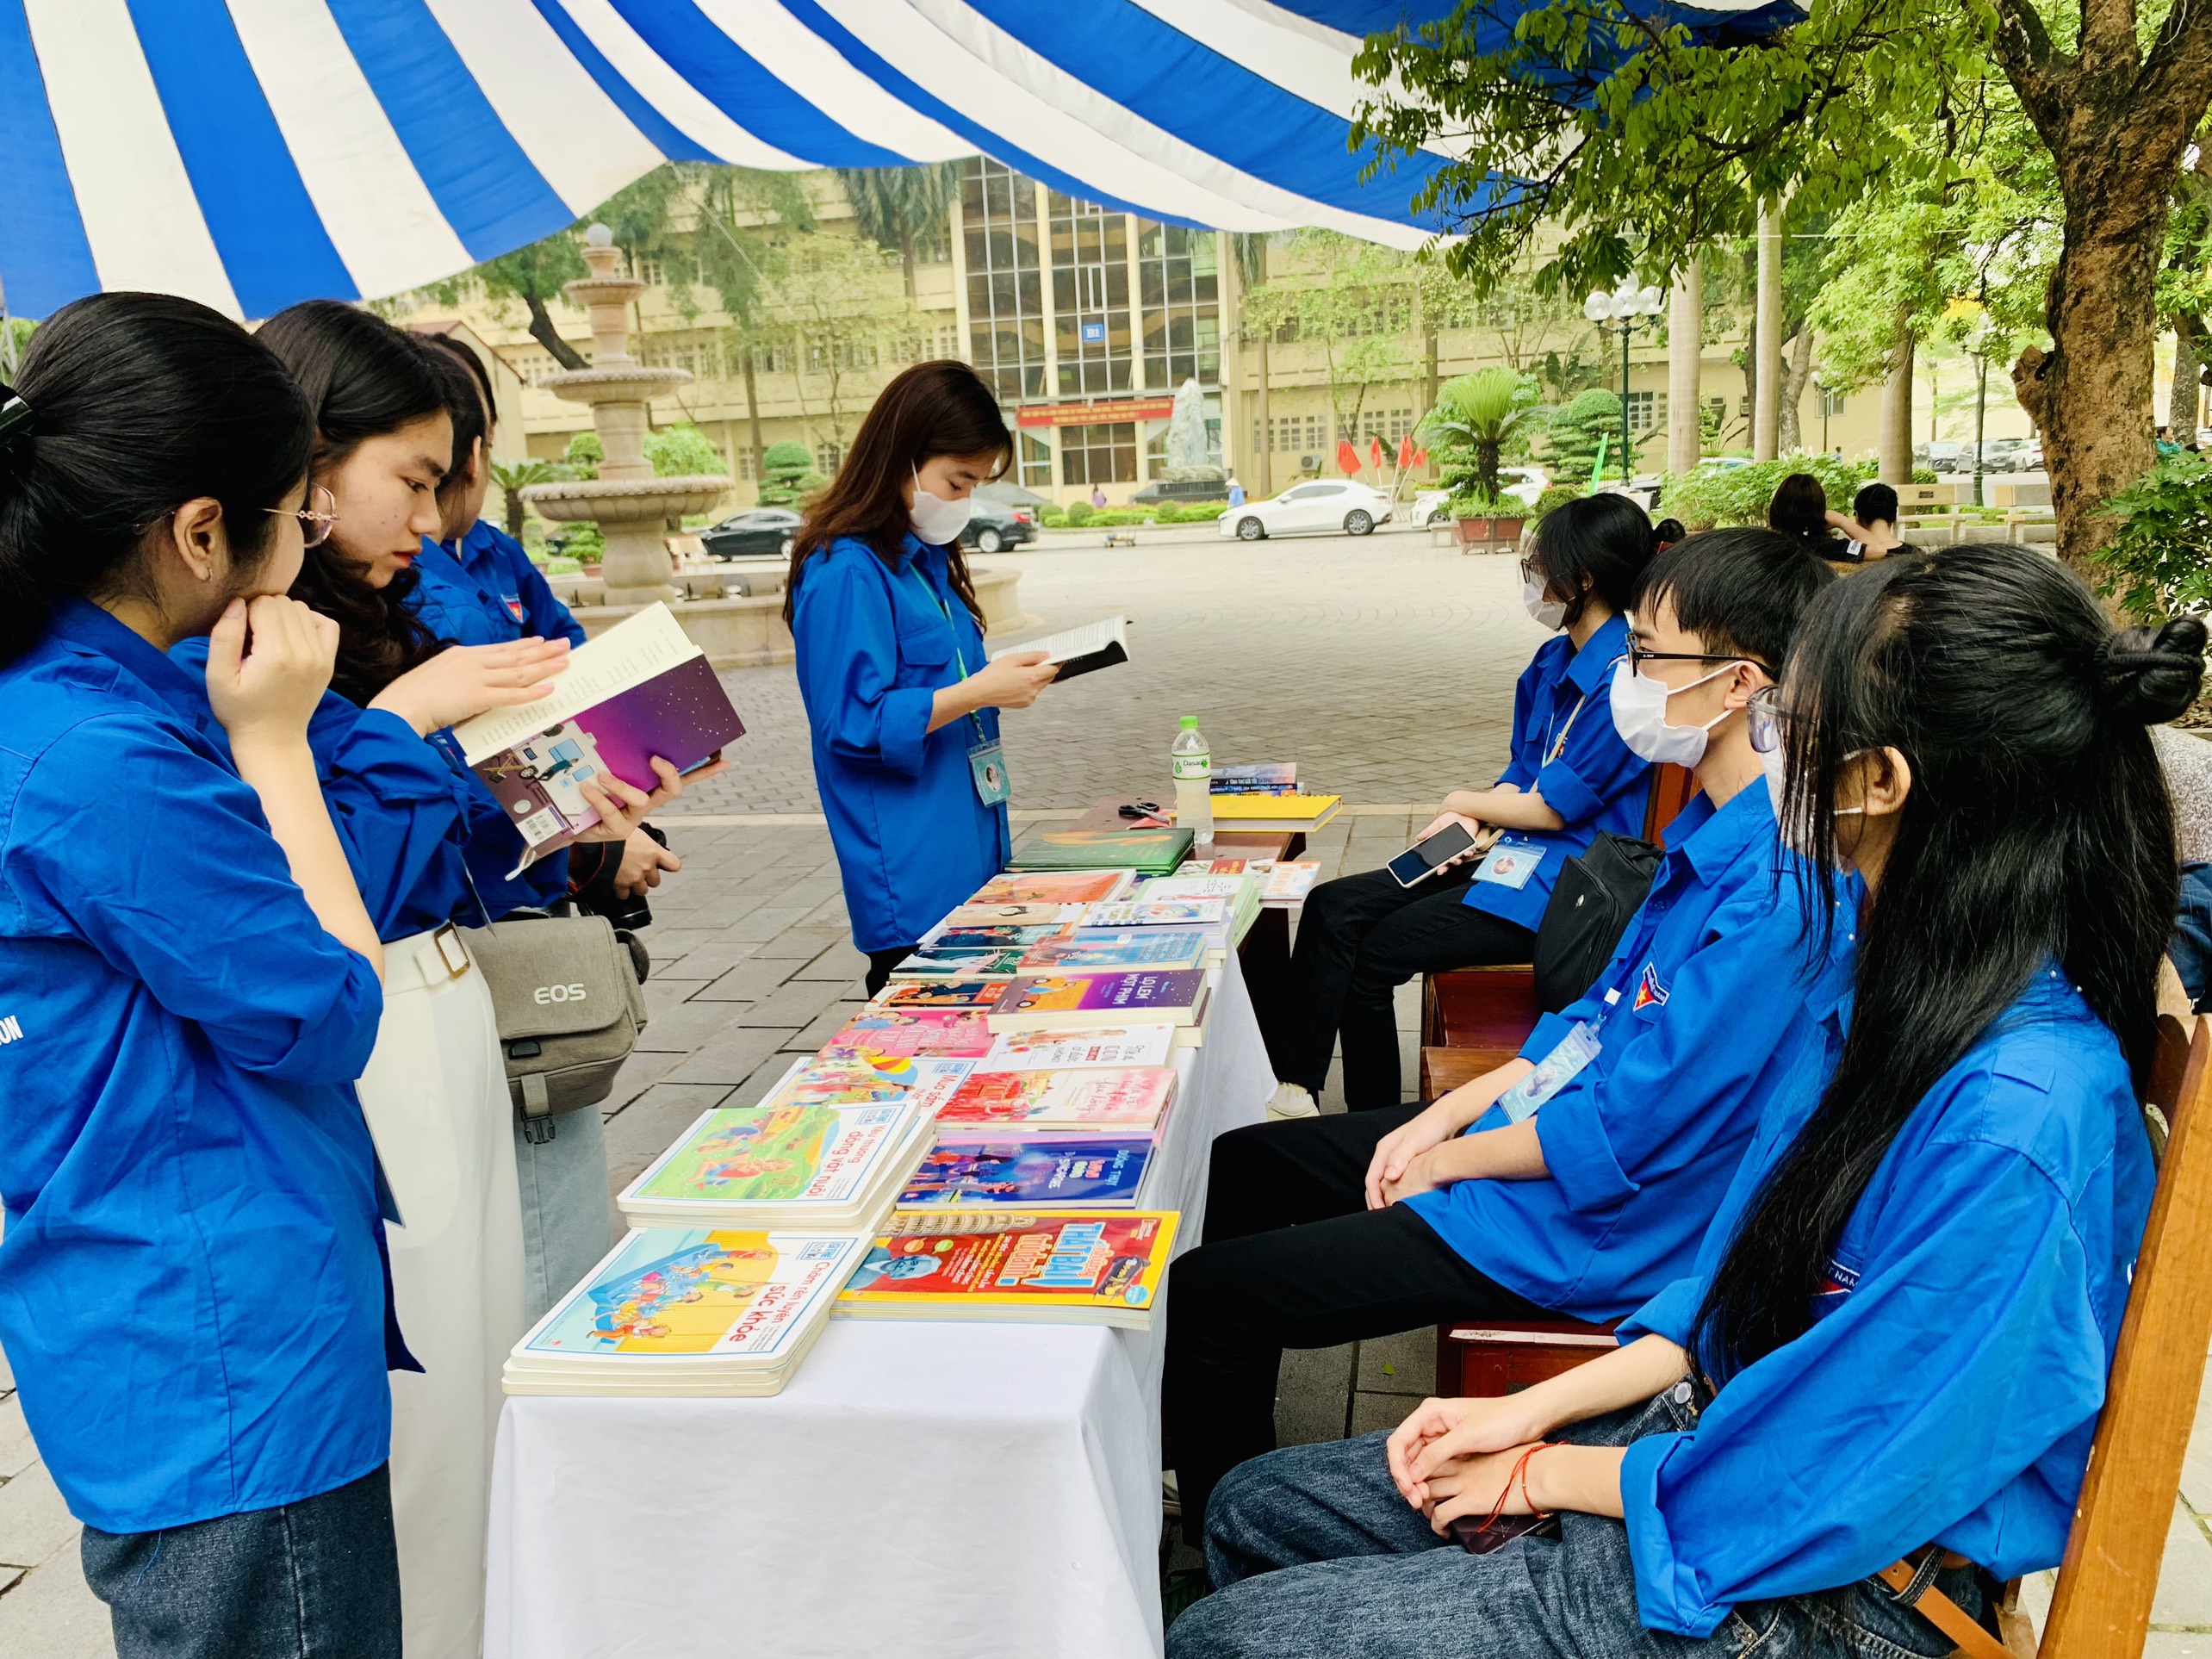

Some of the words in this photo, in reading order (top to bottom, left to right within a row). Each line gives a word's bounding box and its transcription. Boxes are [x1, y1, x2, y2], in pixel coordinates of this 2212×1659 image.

[1086, 328, 1101, 338] B1
[534, 983, 587, 1004] EOS
[1112, 987, 1133, 1004] PHIM
[935, 1075, 959, 1090] Mua
[867, 1124, 887, 1137] Yêu
[831, 1131, 863, 1155] động
[824, 1158, 843, 1172] vật
[809, 1175, 833, 1196] nuôi
[1051, 1222, 1110, 1253] THẤT
[805, 1262, 830, 1284] Chăm
[1037, 1254, 1090, 1278] BẠI
[763, 1285, 786, 1307] sức
[790, 1286, 807, 1301] rèn
[772, 1301, 798, 1323] luyện
[729, 1310, 773, 1342] khỏe
